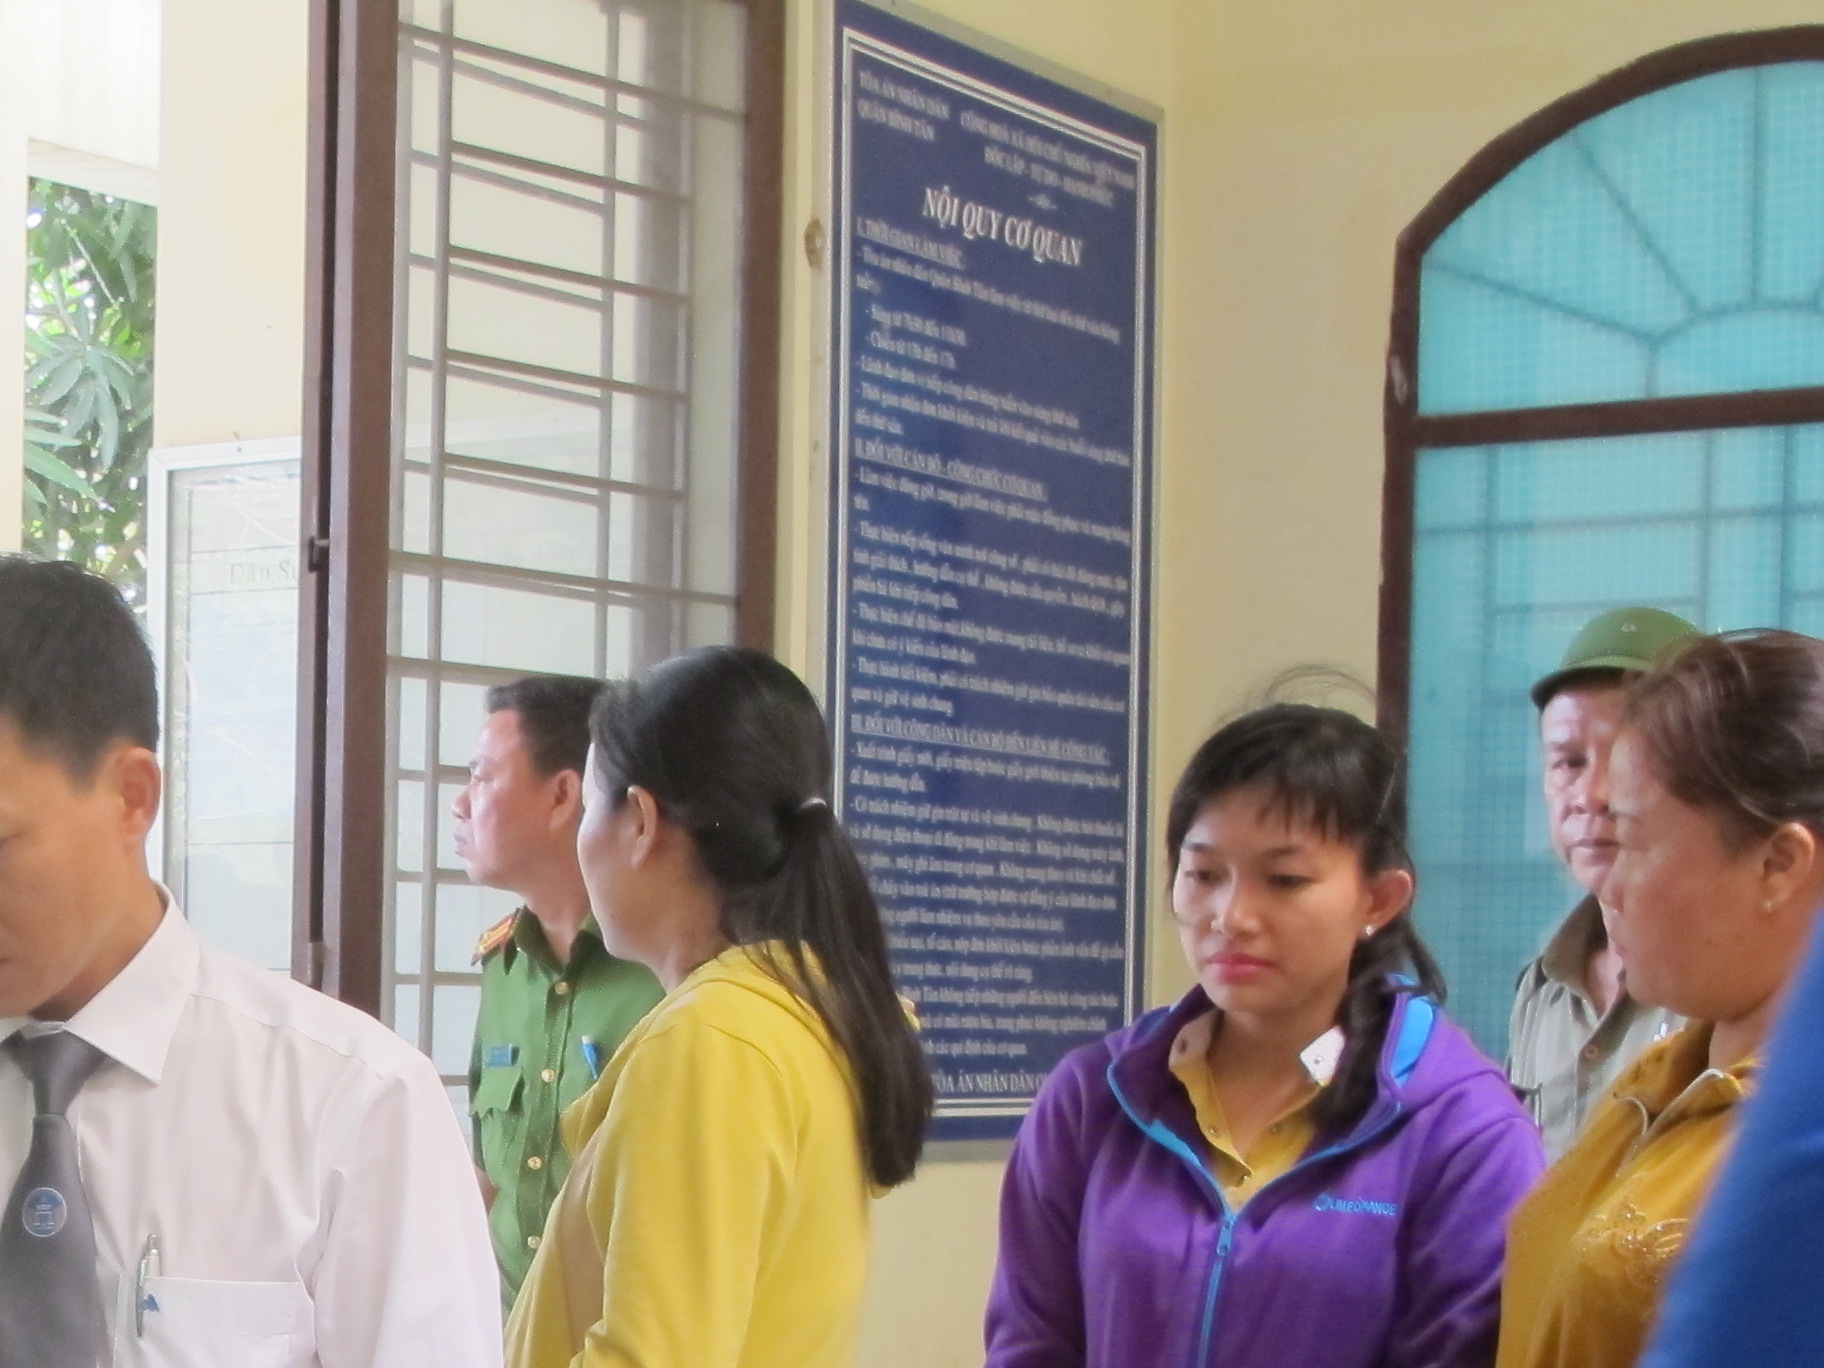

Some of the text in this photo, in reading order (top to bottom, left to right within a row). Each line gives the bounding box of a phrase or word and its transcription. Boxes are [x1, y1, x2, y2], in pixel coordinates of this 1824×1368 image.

[923, 184, 1082, 267] NỘI QUY CƠ QUAN
[957, 1068, 974, 1092] ÁN
[976, 1067, 1008, 1092] NHÂN
[1010, 1067, 1034, 1092] DÂN
